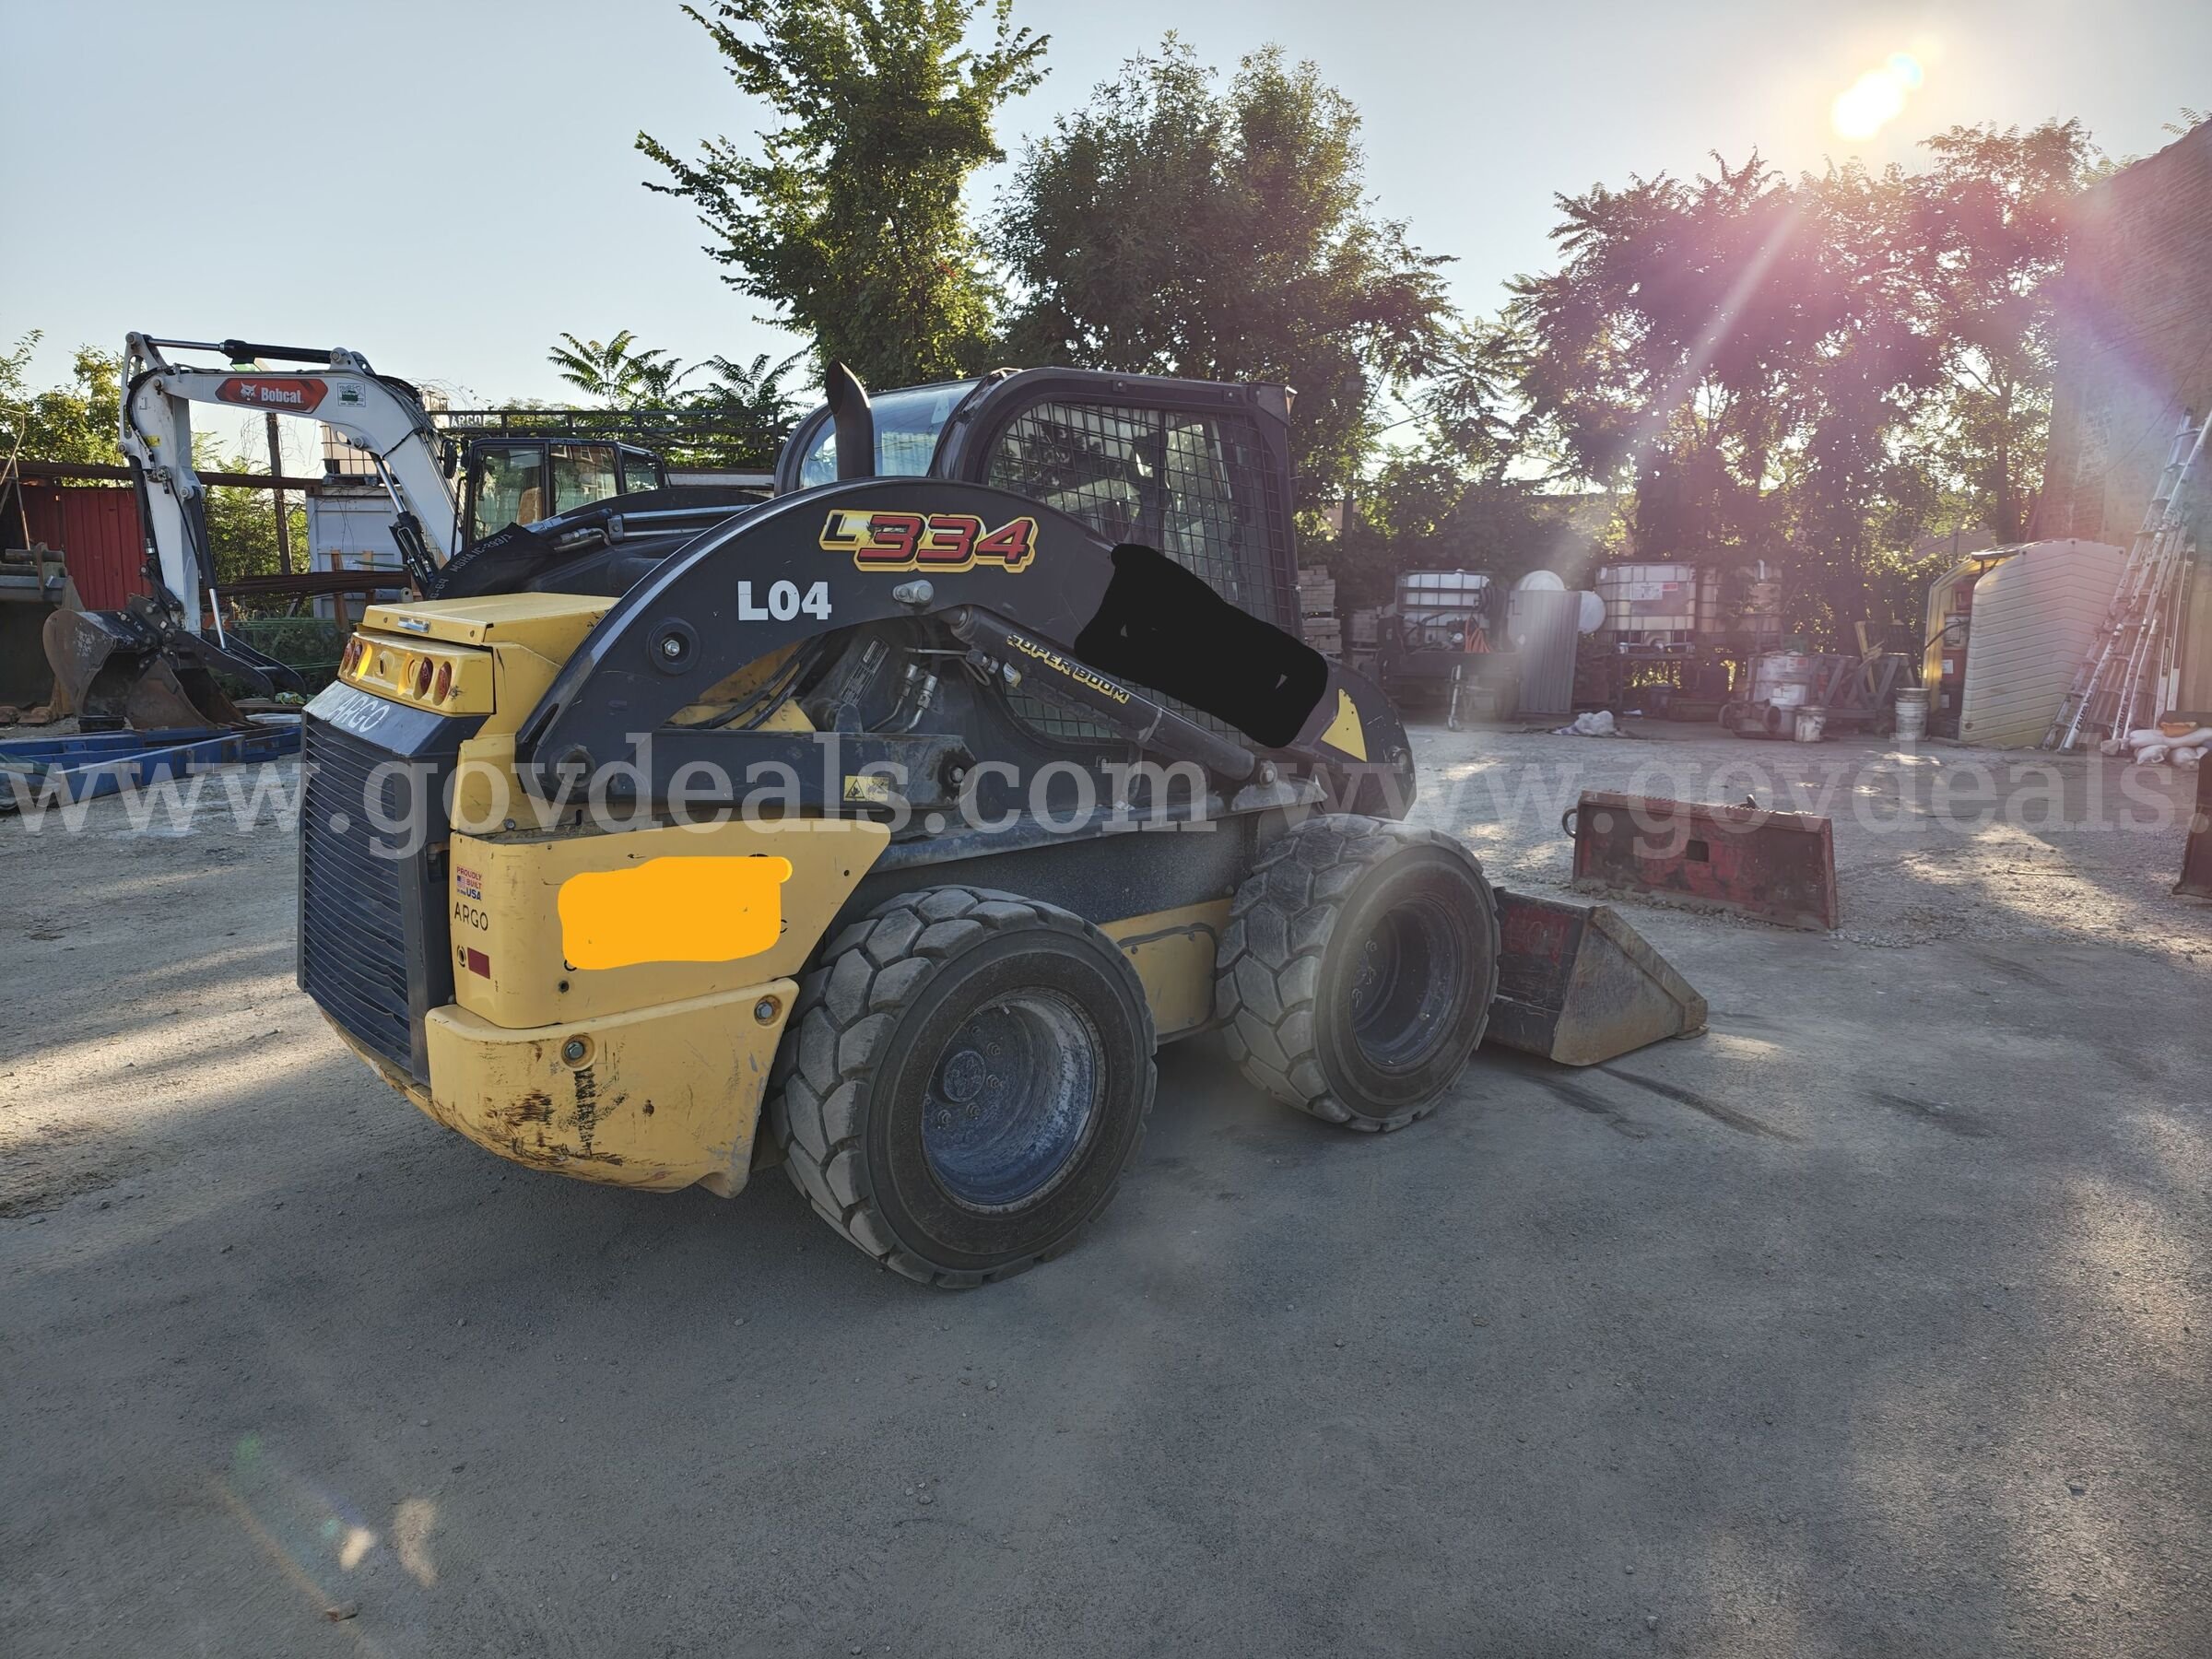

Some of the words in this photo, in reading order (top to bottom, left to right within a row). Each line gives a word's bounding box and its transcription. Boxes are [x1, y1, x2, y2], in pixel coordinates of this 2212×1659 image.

[261, 387, 303, 404] Bobcat
[737, 580, 832, 621] L04
[1072, 666, 1130, 705] BOOM
[328, 693, 391, 733] ARGO
[456, 866, 482, 880] PROUDLY
[466, 878, 482, 889] BUILT
[466, 888, 482, 900] USA
[454, 901, 488, 931] ARGO
